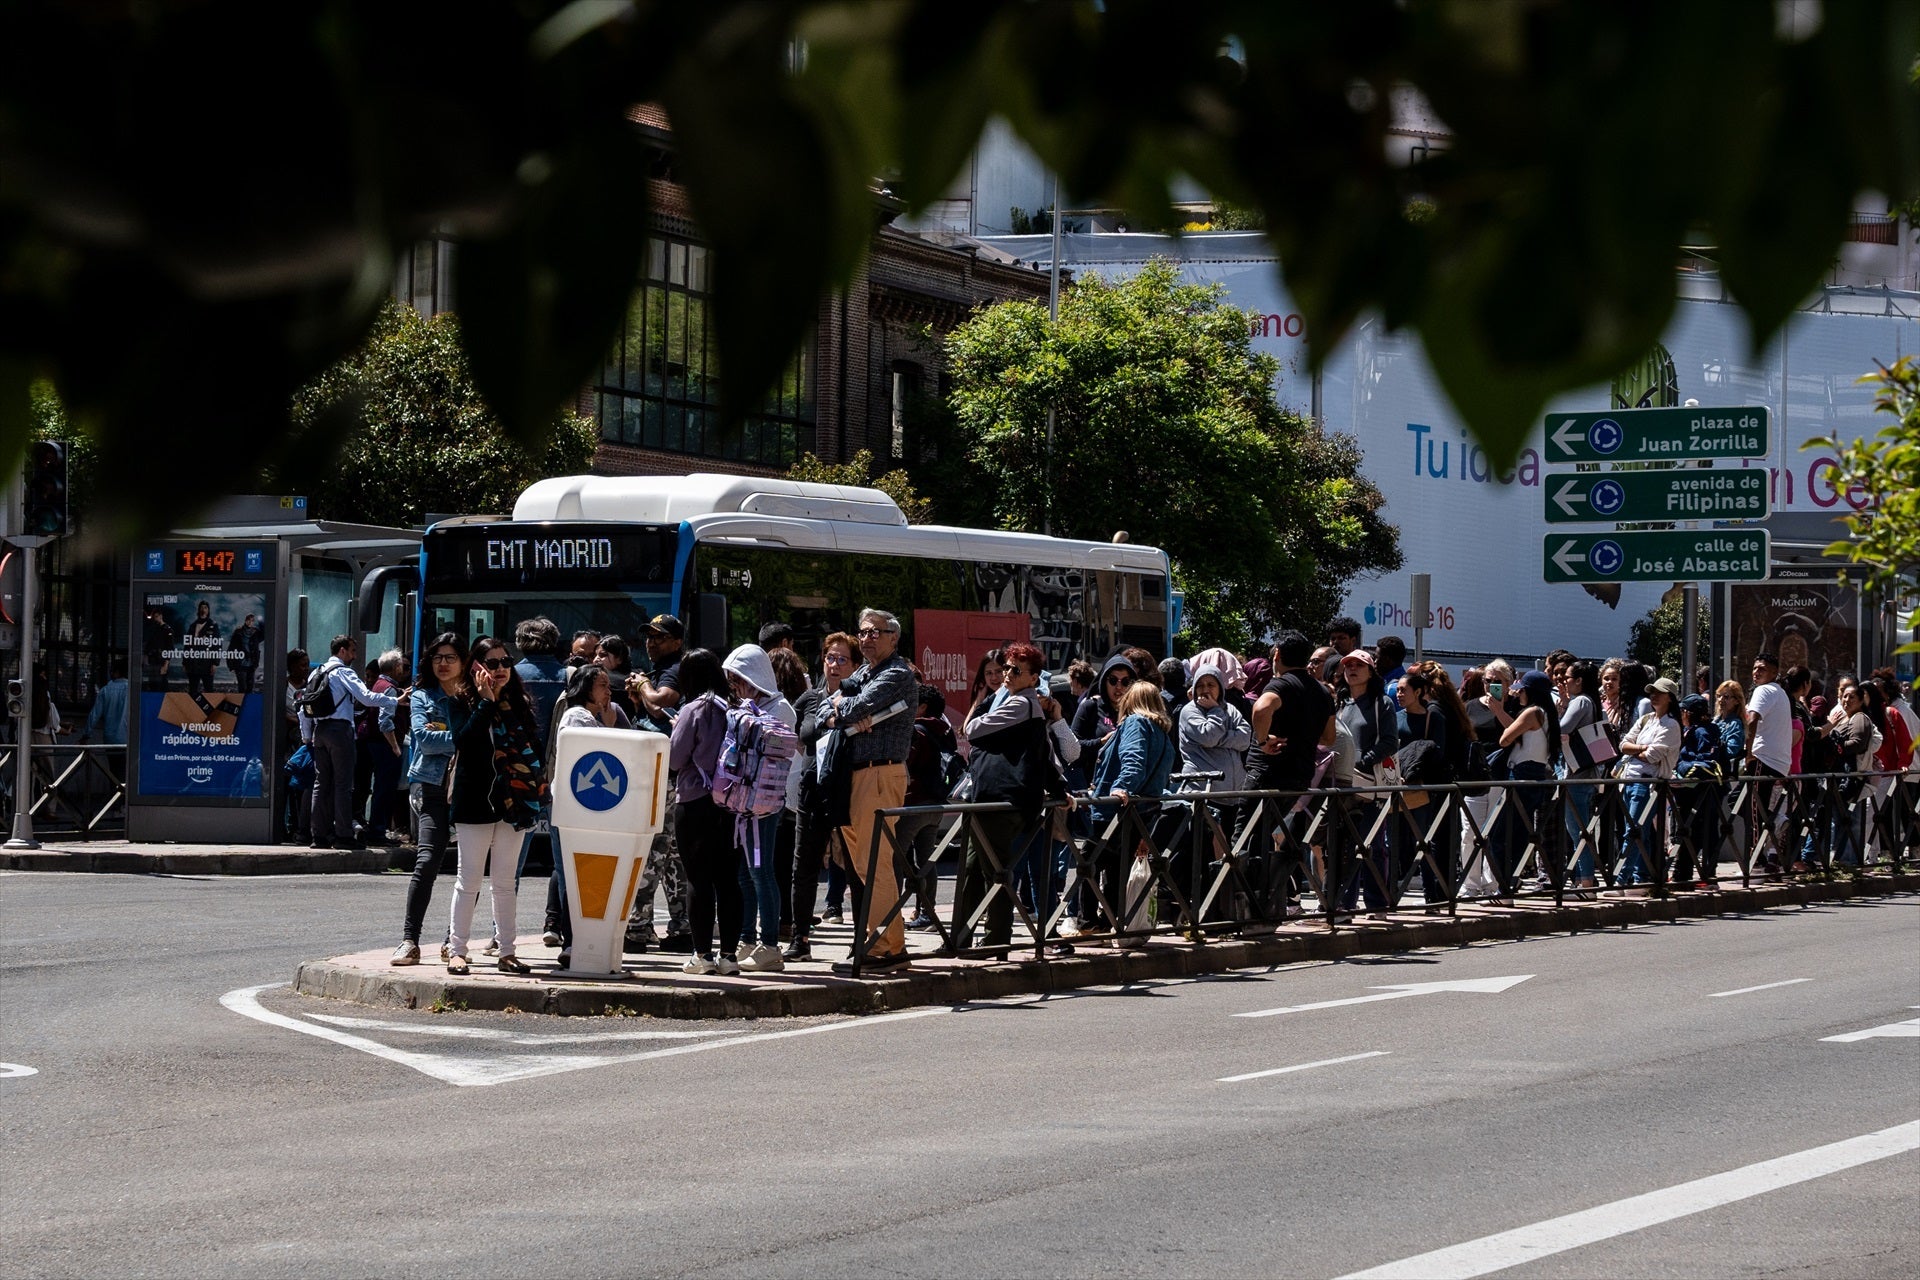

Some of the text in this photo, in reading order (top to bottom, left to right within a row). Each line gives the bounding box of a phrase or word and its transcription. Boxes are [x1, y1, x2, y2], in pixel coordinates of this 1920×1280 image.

[1691, 415, 1759, 432] plaza de
[1638, 434, 1759, 452] Juan Zorrilla
[1407, 423, 1449, 479] Tu
[1671, 476, 1760, 490] avenida de
[1667, 492, 1760, 513] Filipinas
[1694, 538, 1759, 552] calle de
[487, 538, 612, 569] EMT MADRID
[183, 551, 235, 571] 14:47
[1633, 556, 1759, 573] José Abascal
[1771, 598, 1817, 607] MAGNUM
[1378, 602, 1455, 630] iPhoe 16
[183, 634, 224, 648] El mejor
[161, 648, 246, 660] entretenimiento
[181, 720, 222, 733] y envíos
[162, 733, 240, 747] rápidos y gratis
[154, 753, 168, 761] Está
[191, 755, 200, 763] por
[187, 765, 213, 777] prime
